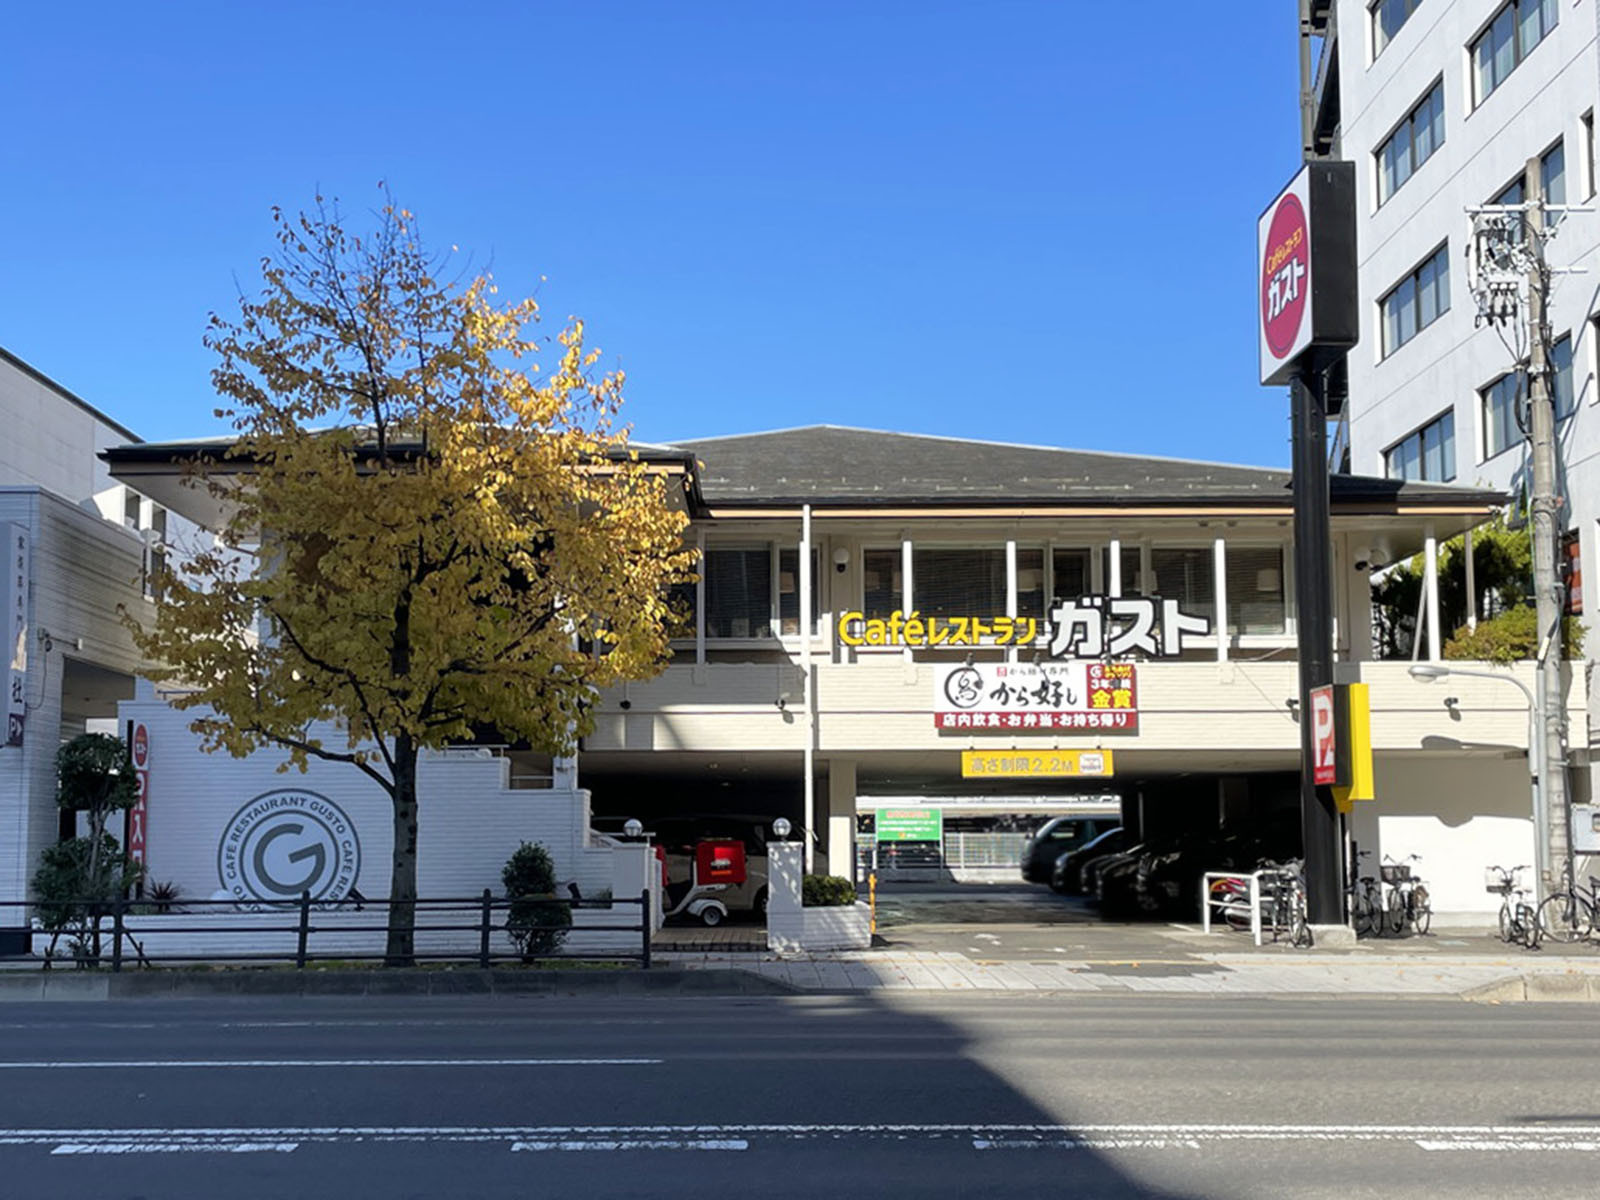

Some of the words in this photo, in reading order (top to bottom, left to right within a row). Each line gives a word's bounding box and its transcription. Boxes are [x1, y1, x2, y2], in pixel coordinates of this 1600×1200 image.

[1268, 257, 1305, 322] ガスト
[1051, 596, 1209, 657] ガスト
[1091, 689, 1132, 709] 金賞
[231, 797, 308, 842] RESTAURANT
[310, 801, 346, 835] GUSTO
[225, 844, 238, 880] CAFE
[253, 823, 326, 896] G
[341, 839, 353, 874] CAFE
